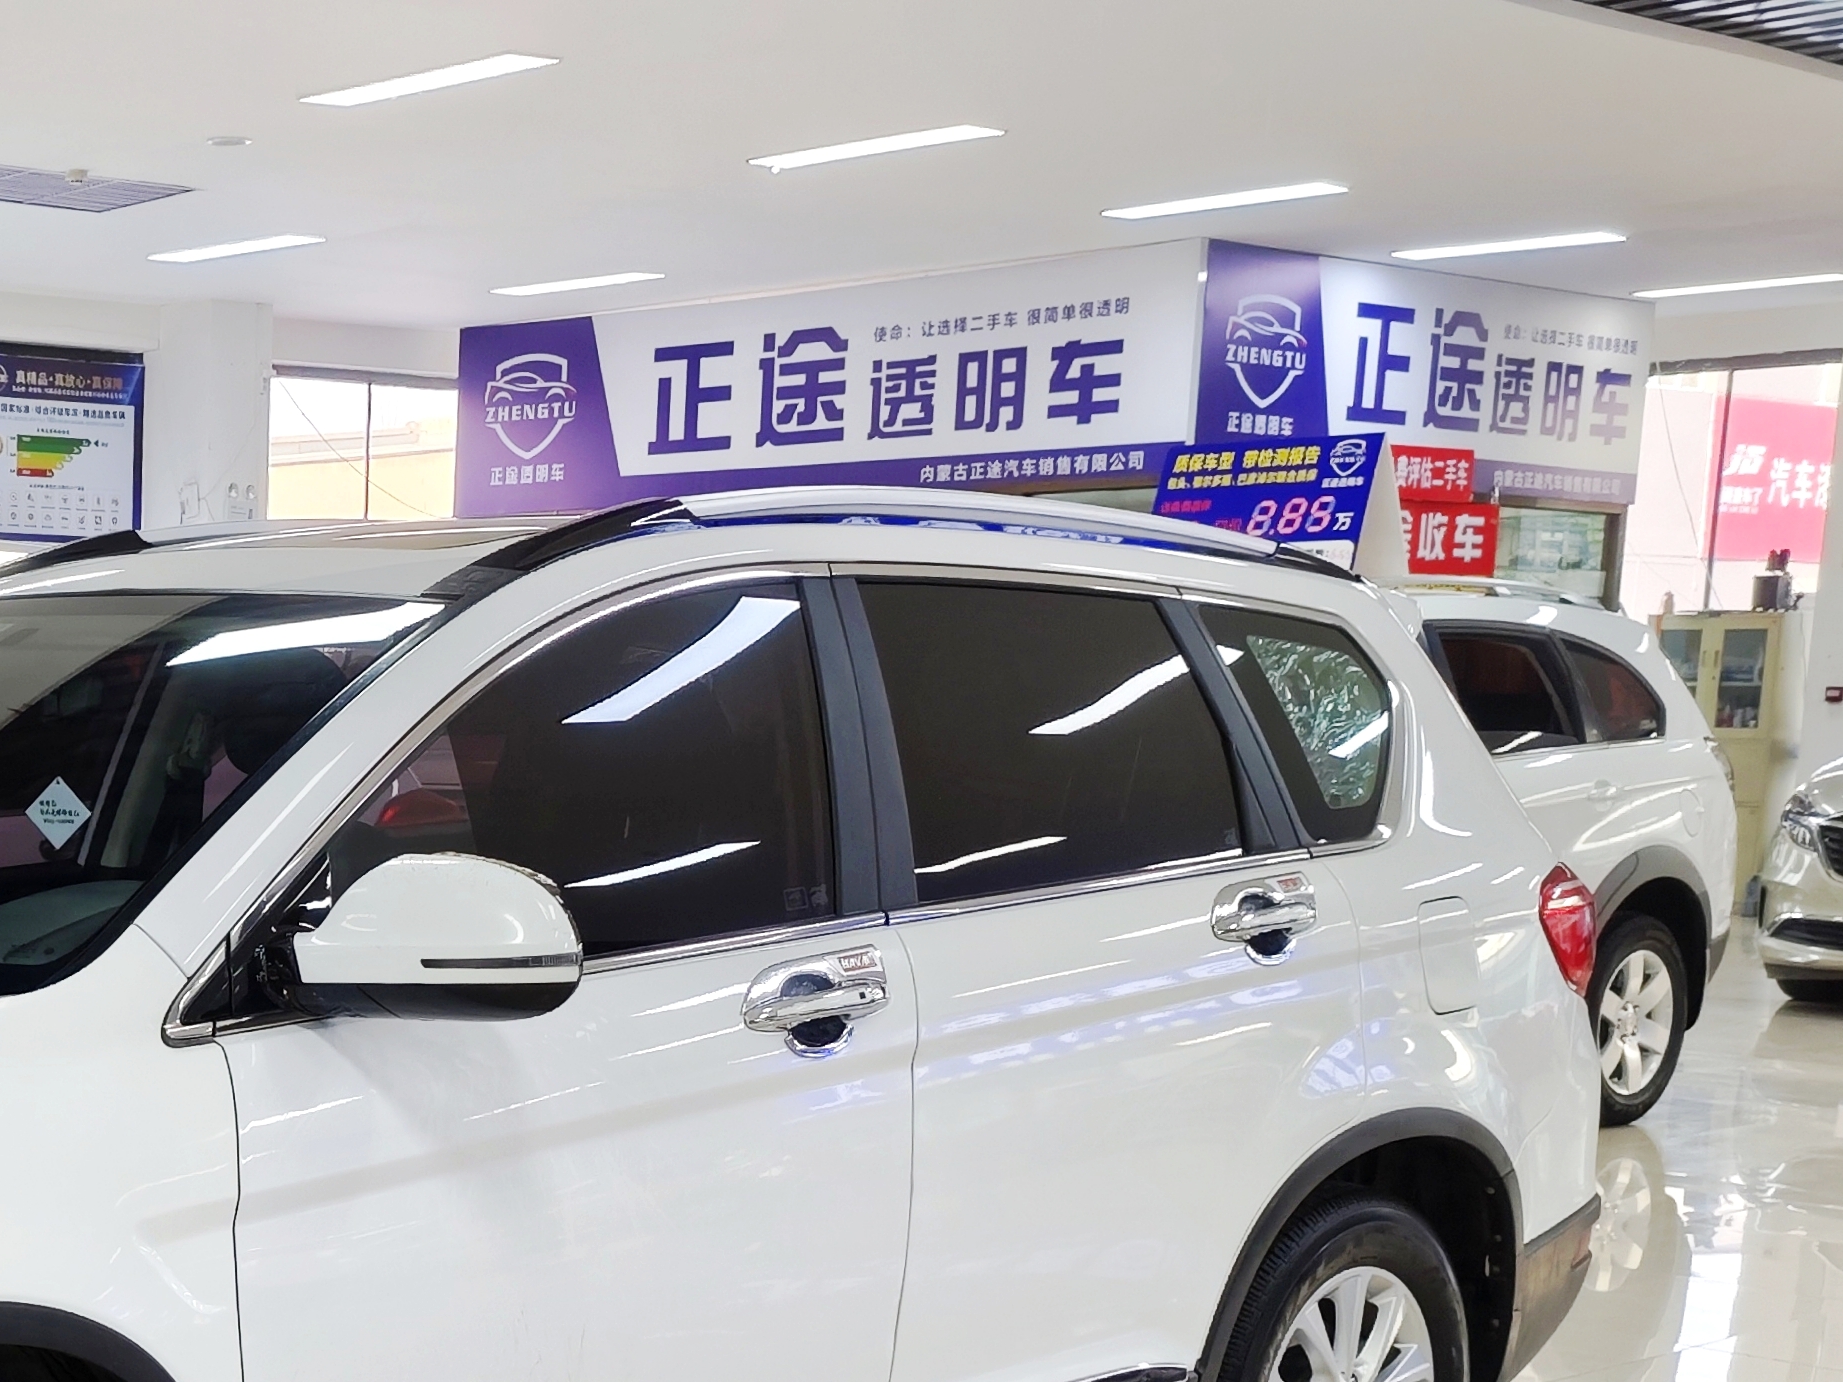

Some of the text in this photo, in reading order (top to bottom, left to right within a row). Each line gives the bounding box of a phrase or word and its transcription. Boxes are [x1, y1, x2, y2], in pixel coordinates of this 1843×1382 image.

[1027, 297, 1131, 327] 很简单很透明
[1225, 344, 1307, 370] ZHENGTU
[1346, 302, 1633, 446] 正途透明车
[648, 326, 1125, 455] 正途透明车
[484, 400, 576, 423] ZHENGTU
[1225, 410, 1294, 437] 正途透明车
[489, 463, 565, 486] 正途透明车
[920, 450, 1145, 483] 内蒙古正途汽车销售有限公司
